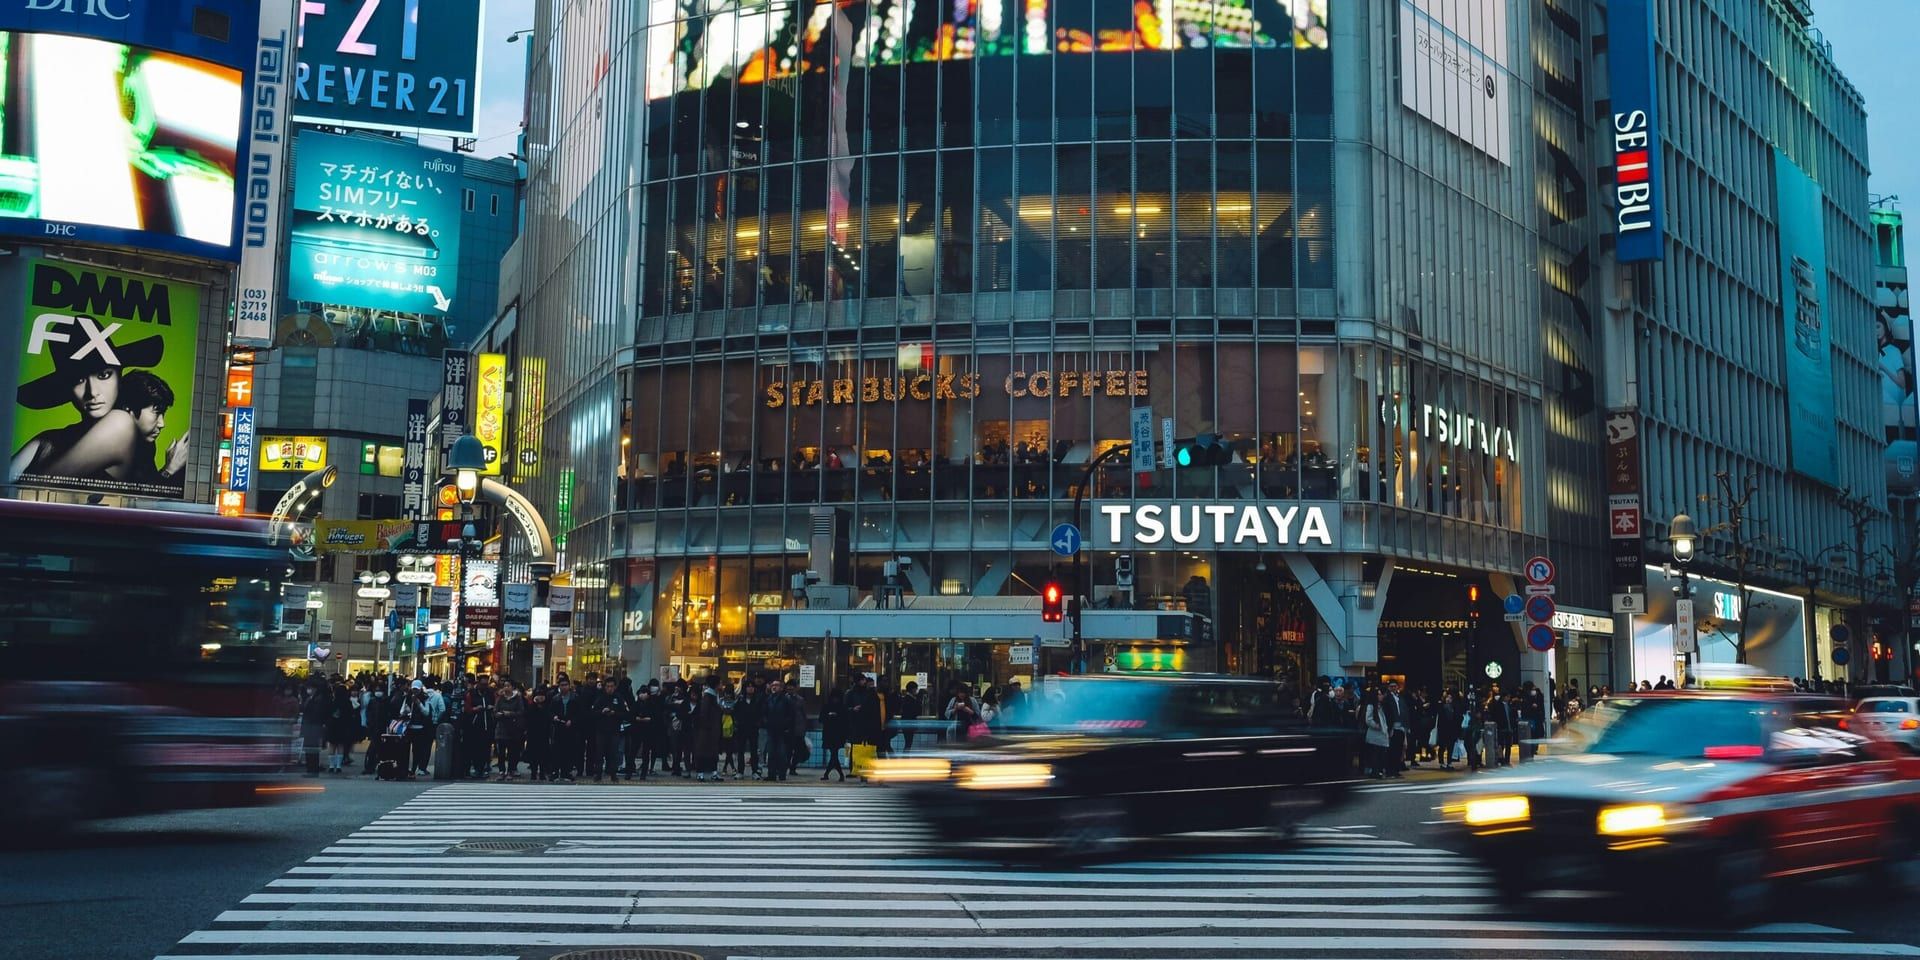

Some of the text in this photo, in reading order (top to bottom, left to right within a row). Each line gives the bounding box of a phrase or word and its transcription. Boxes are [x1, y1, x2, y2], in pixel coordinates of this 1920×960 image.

[427, 76, 466, 116] 21
[246, 29, 287, 248] Taisei neon
[319, 161, 443, 194] マチガイない、
[423, 158, 456, 174] FUJITSU
[1614, 110, 1651, 233] SEIBU
[319, 183, 418, 209] SIMフリー
[45, 222, 76, 236] DHC
[316, 205, 440, 237] スマホがある。
[313, 253, 437, 277] arrows M03
[32, 263, 172, 326] DMM
[241, 301, 267, 311] 3719
[244, 289, 266, 300] (03)
[240, 311, 267, 321] 2468
[26, 314, 121, 366] FX
[767, 369, 1149, 409] STARBUCKS COFFEE
[233, 412, 252, 487] 大盛堂商事ビル
[1140, 412, 1152, 467] 渋谷駅前
[403, 414, 426, 521] 洋服の青
[1101, 504, 1332, 545] TSUTAYA
[1615, 511, 1634, 532] 本
[1615, 555, 1638, 563] WIRED
